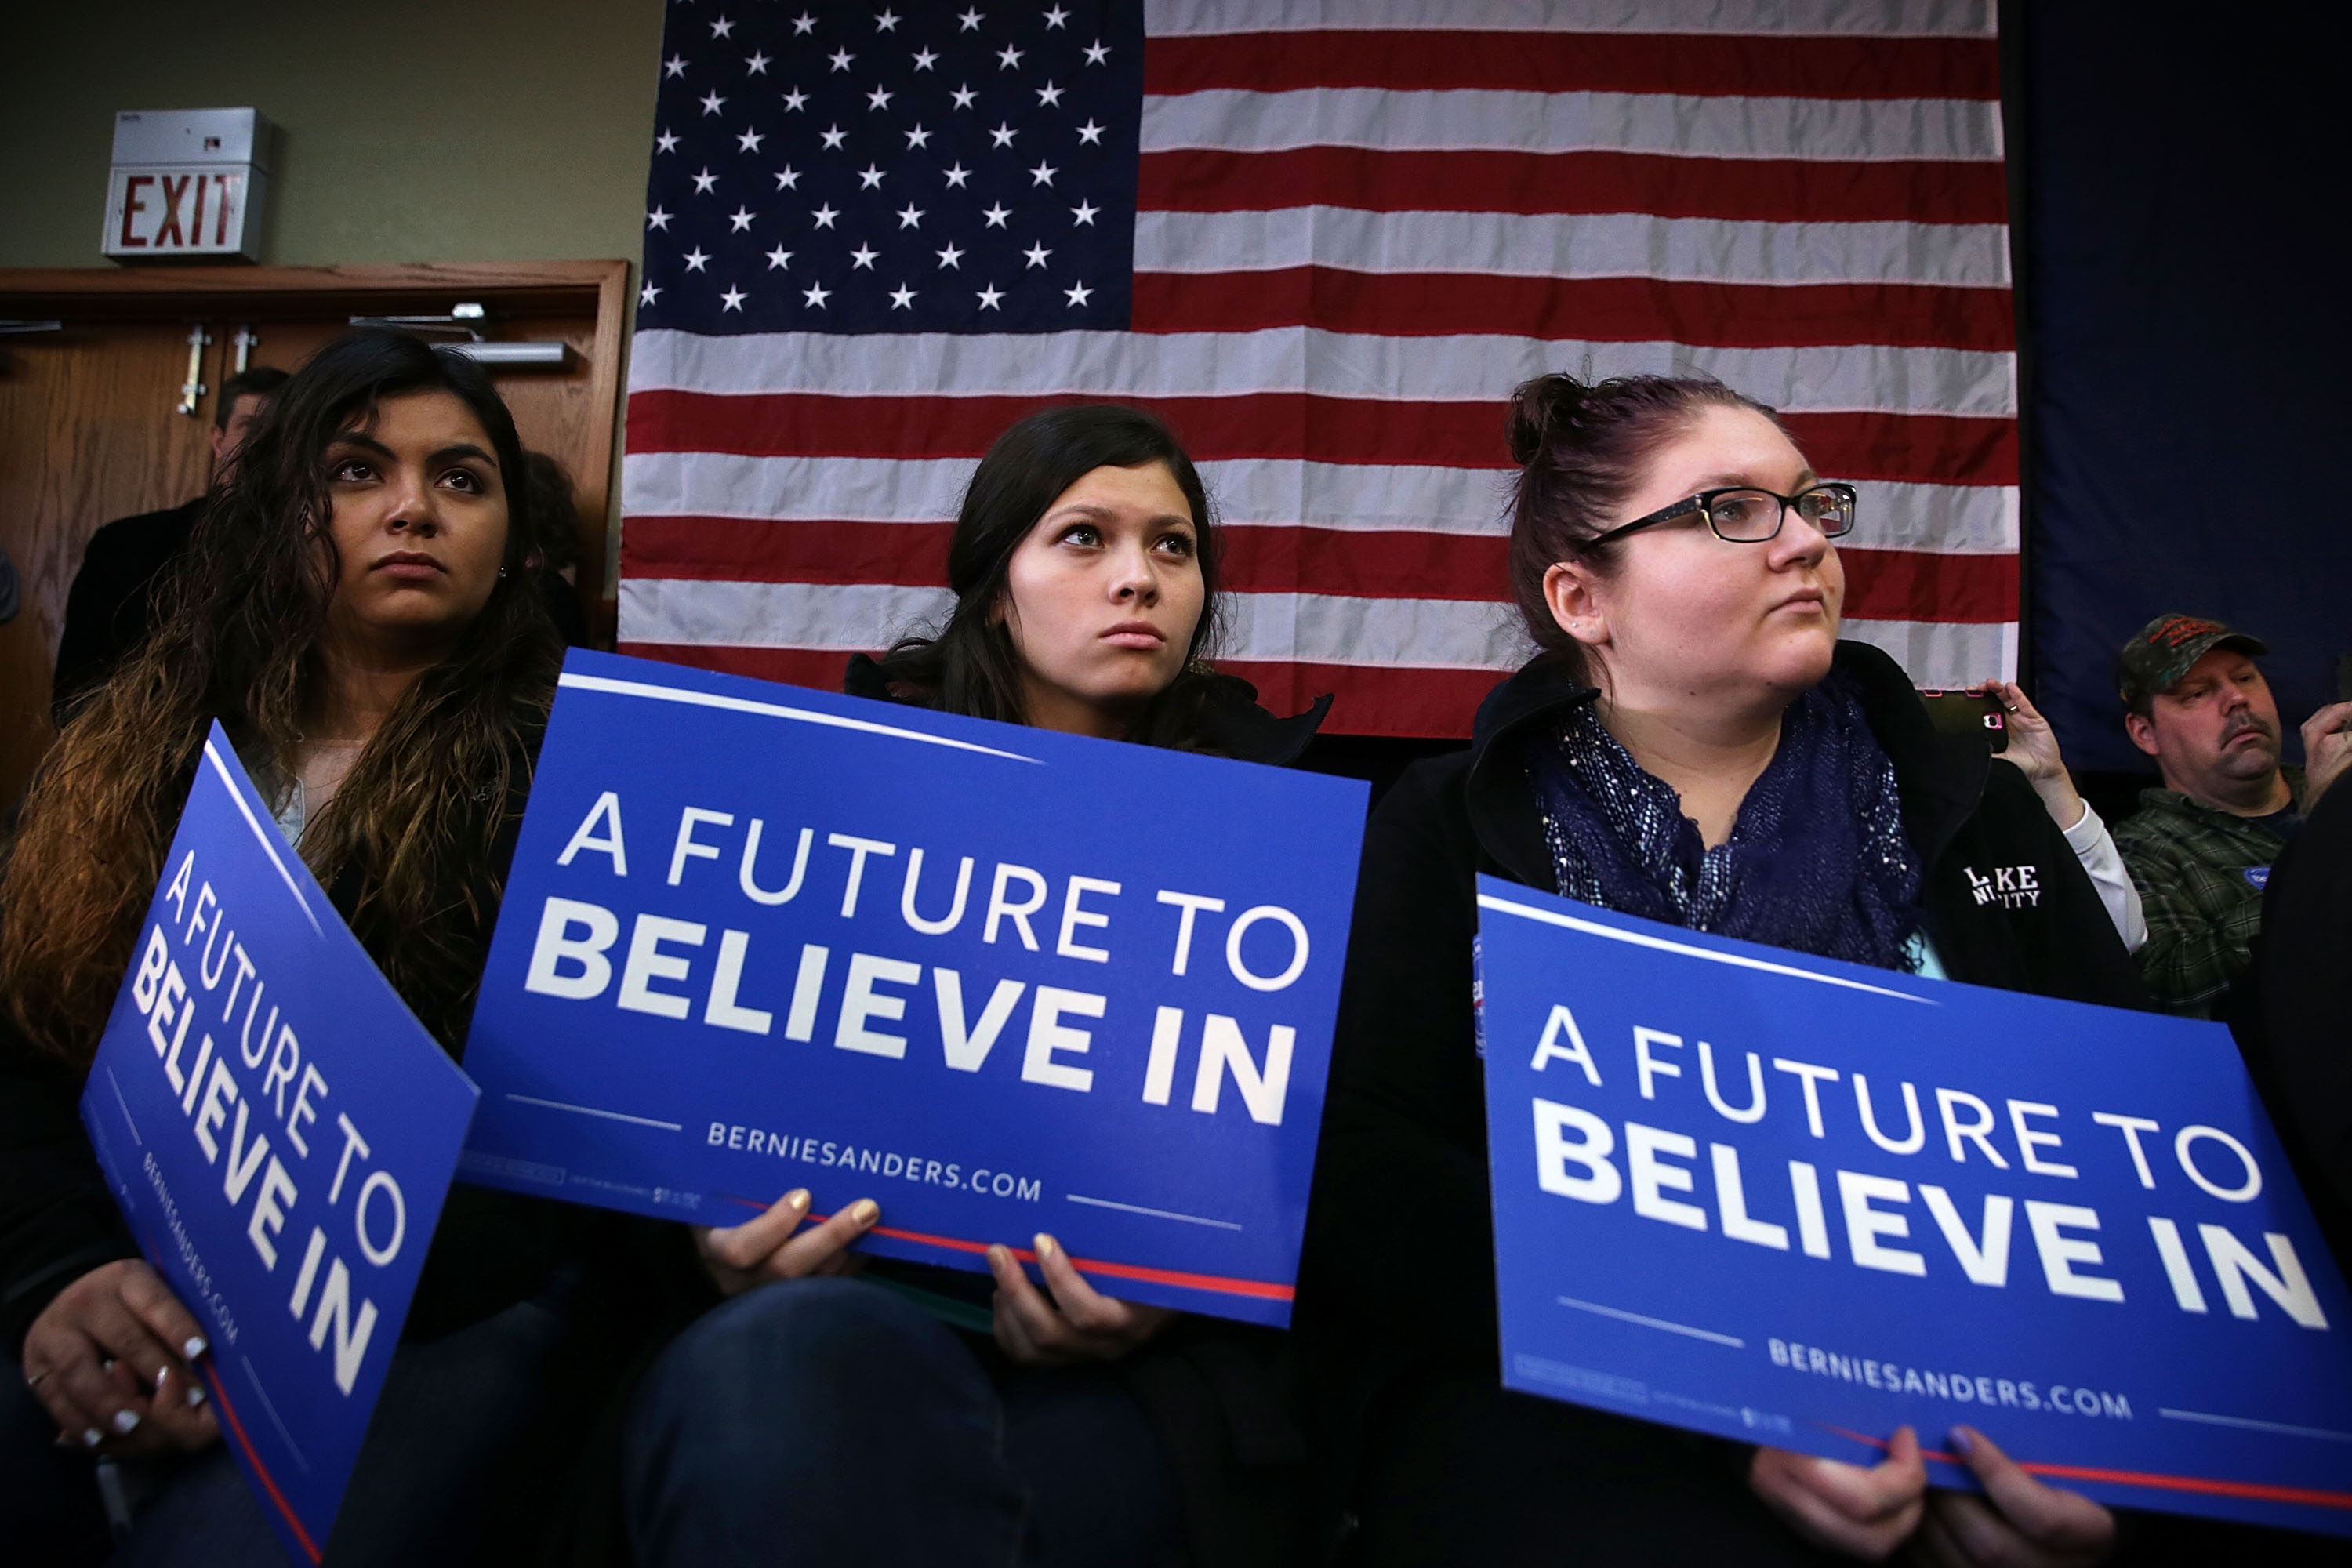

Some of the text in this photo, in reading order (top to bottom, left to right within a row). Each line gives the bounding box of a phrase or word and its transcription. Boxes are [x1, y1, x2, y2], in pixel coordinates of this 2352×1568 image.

[121, 175, 240, 247] EXIT
[557, 791, 1310, 992] A FUTURE TO
[1962, 866, 2038, 891] LKE
[164, 848, 406, 1268] A FUTURE TO
[524, 896, 1296, 1127] BELIEVE IN
[1530, 1004, 2263, 1203] A FUTURE TO
[132, 922, 378, 1397] BELIEVE IN
[143, 1151, 238, 1344] BERNIESANDERS.COM
[707, 1123, 1041, 1201] BERNIESANDERS.COM
[1532, 1097, 2330, 1330] BELIEVE IN
[1768, 1336, 2133, 1421] BERNIESANDERS.COM
